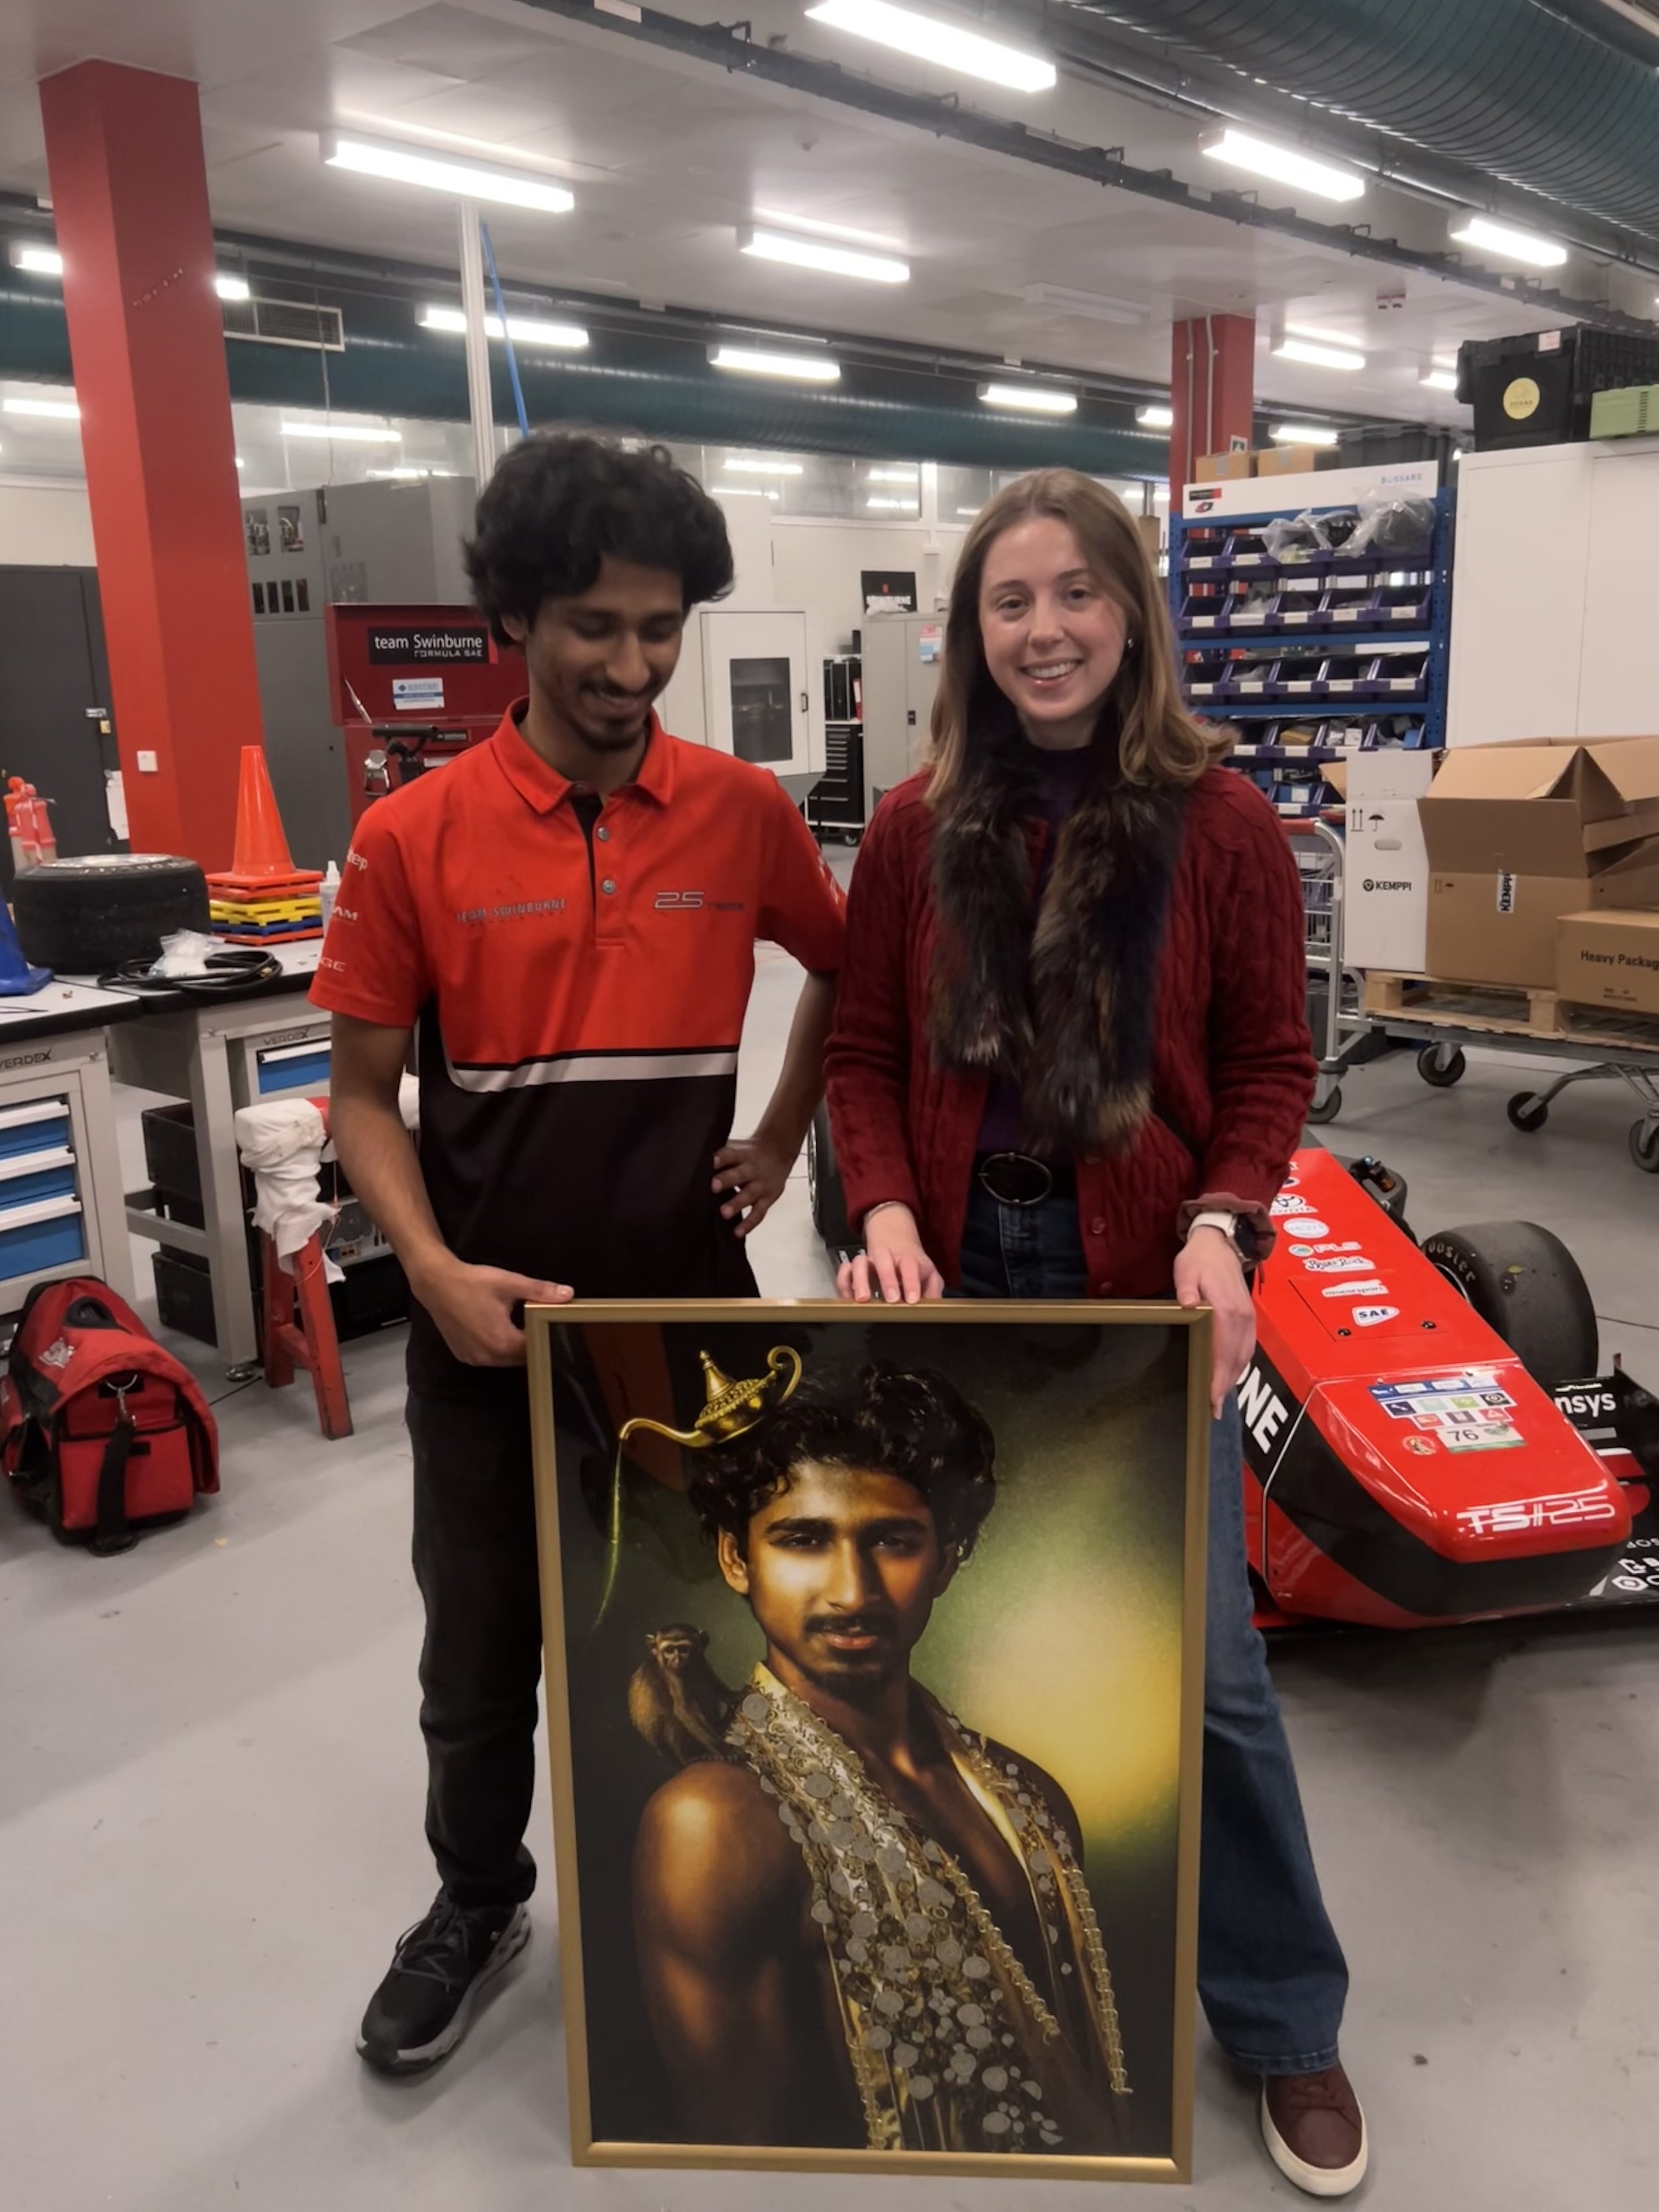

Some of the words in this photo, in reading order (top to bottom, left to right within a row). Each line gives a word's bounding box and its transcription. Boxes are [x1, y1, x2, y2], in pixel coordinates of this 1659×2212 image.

[374, 636, 409, 649] team
[413, 633, 482, 648] Swinburne
[414, 649, 461, 658] FORMULA
[1376, 881, 1411, 891] KEMPPI
[654, 891, 705, 909] 25
[1581, 950, 1615, 966] Heavy
[263, 1027, 310, 1045] VERDEX
[1358, 1309, 1389, 1319] SAE
[1447, 1429, 1480, 1442] 76
